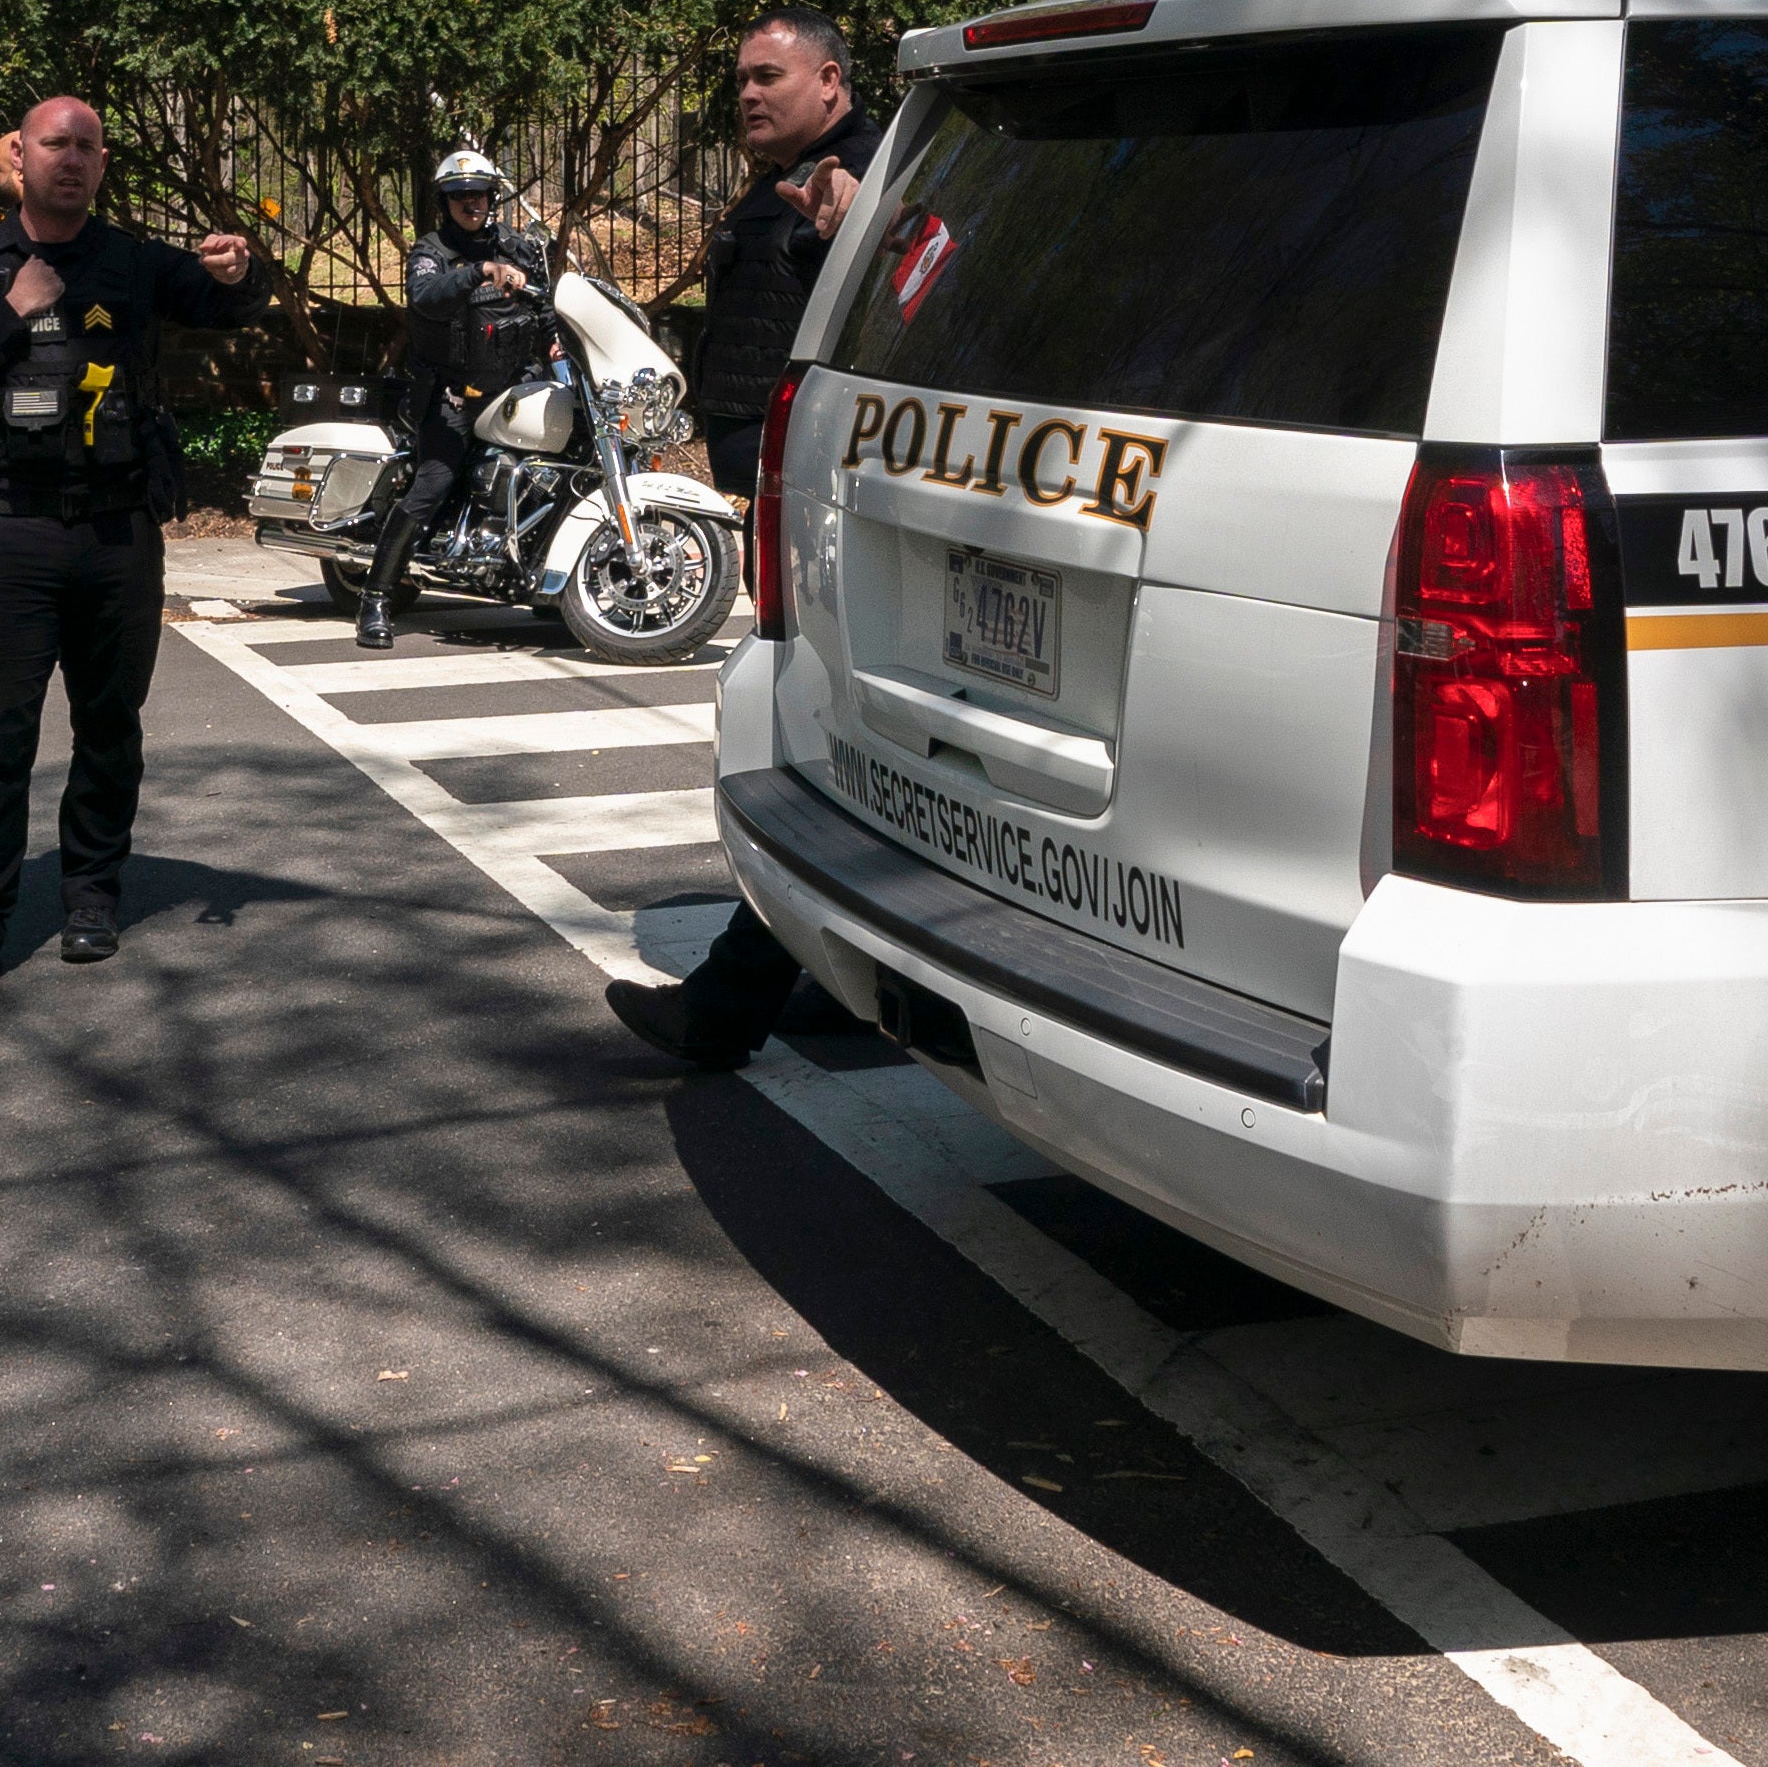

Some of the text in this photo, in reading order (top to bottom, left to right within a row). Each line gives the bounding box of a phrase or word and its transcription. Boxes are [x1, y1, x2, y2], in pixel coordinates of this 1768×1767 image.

[28, 317, 61, 332] VICE
[840, 393, 1169, 533] POLICE
[976, 584, 1046, 659] 4762V
[831, 733, 1185, 949] WWW.SECRETSERVICE.GOV/JOIN
